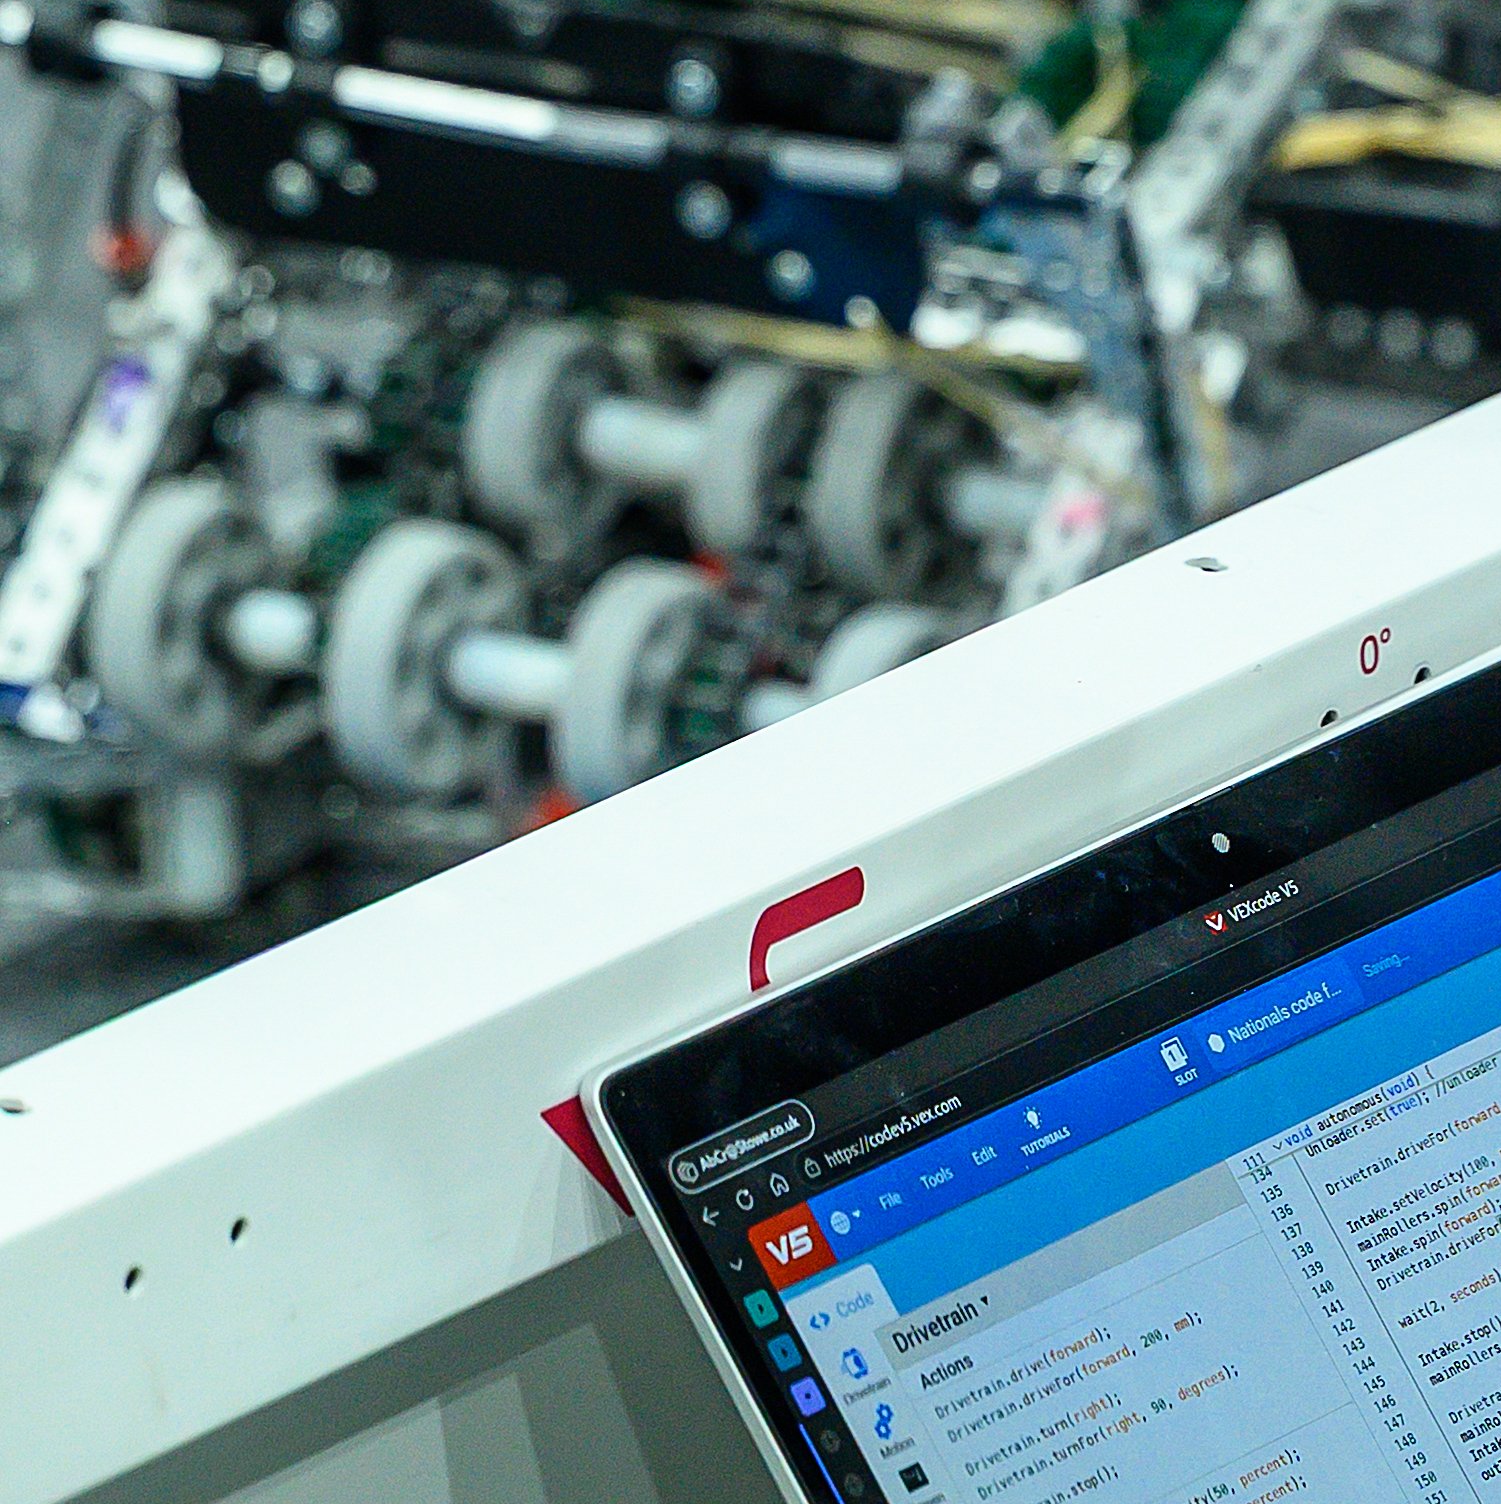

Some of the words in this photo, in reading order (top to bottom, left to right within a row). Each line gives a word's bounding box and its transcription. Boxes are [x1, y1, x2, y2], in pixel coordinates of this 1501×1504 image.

[1226, 890, 1281, 921] VEXcode
[1279, 879, 1299, 897] V5
[1227, 1005, 1290, 1043] Nationals
[1290, 990, 1323, 1014] code
[1167, 1049, 1176, 1062] 1
[1174, 1067, 1198, 1086] SLOT
[1242, 1151, 1265, 1170] 111
[1284, 1124, 1313, 1146] void
[1317, 1073, 1419, 1131] autonomous(void)
[1424, 1066, 1435, 1080] {
[1249, 1165, 1272, 1184] 134
[1304, 1091, 1429, 1156] Unloader.set(true);
[1432, 1057, 1496, 1096] //unloader
[824, 1096, 961, 1166] https://codev5.vex.com
[1020, 1126, 1070, 1156] TUTORIALS
[971, 1145, 997, 1165] Edit
[919, 1167, 953, 1189] Tools
[878, 1192, 902, 1210] File
[1260, 1183, 1282, 1203] 135
[1270, 1203, 1293, 1222] 136
[1291, 1241, 1314, 1260] 138
[1346, 1156, 1495, 1233] Intake.setVelocity(100,
[1280, 1222, 1302, 1241] 137
[765, 1225, 814, 1264] V5
[1301, 1260, 1323, 1279] 139
[1311, 1279, 1334, 1298] 140
[835, 1292, 874, 1317] Code
[1321, 1298, 1344, 1318] 141
[892, 1302, 978, 1353] Drivetrain
[1332, 1317, 1355, 1336] 142
[1342, 1336, 1365, 1355] 143
[1397, 1300, 1445, 1328] wait(2,
[920, 1355, 973, 1389] Actions
[934, 1327, 1110, 1418] Drivetrain.drive(forward);
[1352, 1355, 1375, 1375] 144
[947, 1344, 1136, 1442] Drivetrain.driveFor(forward,
[1139, 1328, 1169, 1348] 200,
[1173, 1311, 1201, 1331] mm);
[1363, 1374, 1385, 1393] 145
[1373, 1394, 1396, 1413] 146
[977, 1412, 1146, 1499] Drivetrain.turnFor(right,
[1150, 1397, 1173, 1413] 90,
[1177, 1364, 1238, 1400] degrees);
[1383, 1412, 1405, 1432] 147
[965, 1393, 1121, 1476] Drivetrain.turn(right);
[1394, 1432, 1416, 1451] 148
[1239, 1449, 1300, 1488] percent);
[1404, 1451, 1426, 1470] 149
[1414, 1470, 1437, 1489] 150
